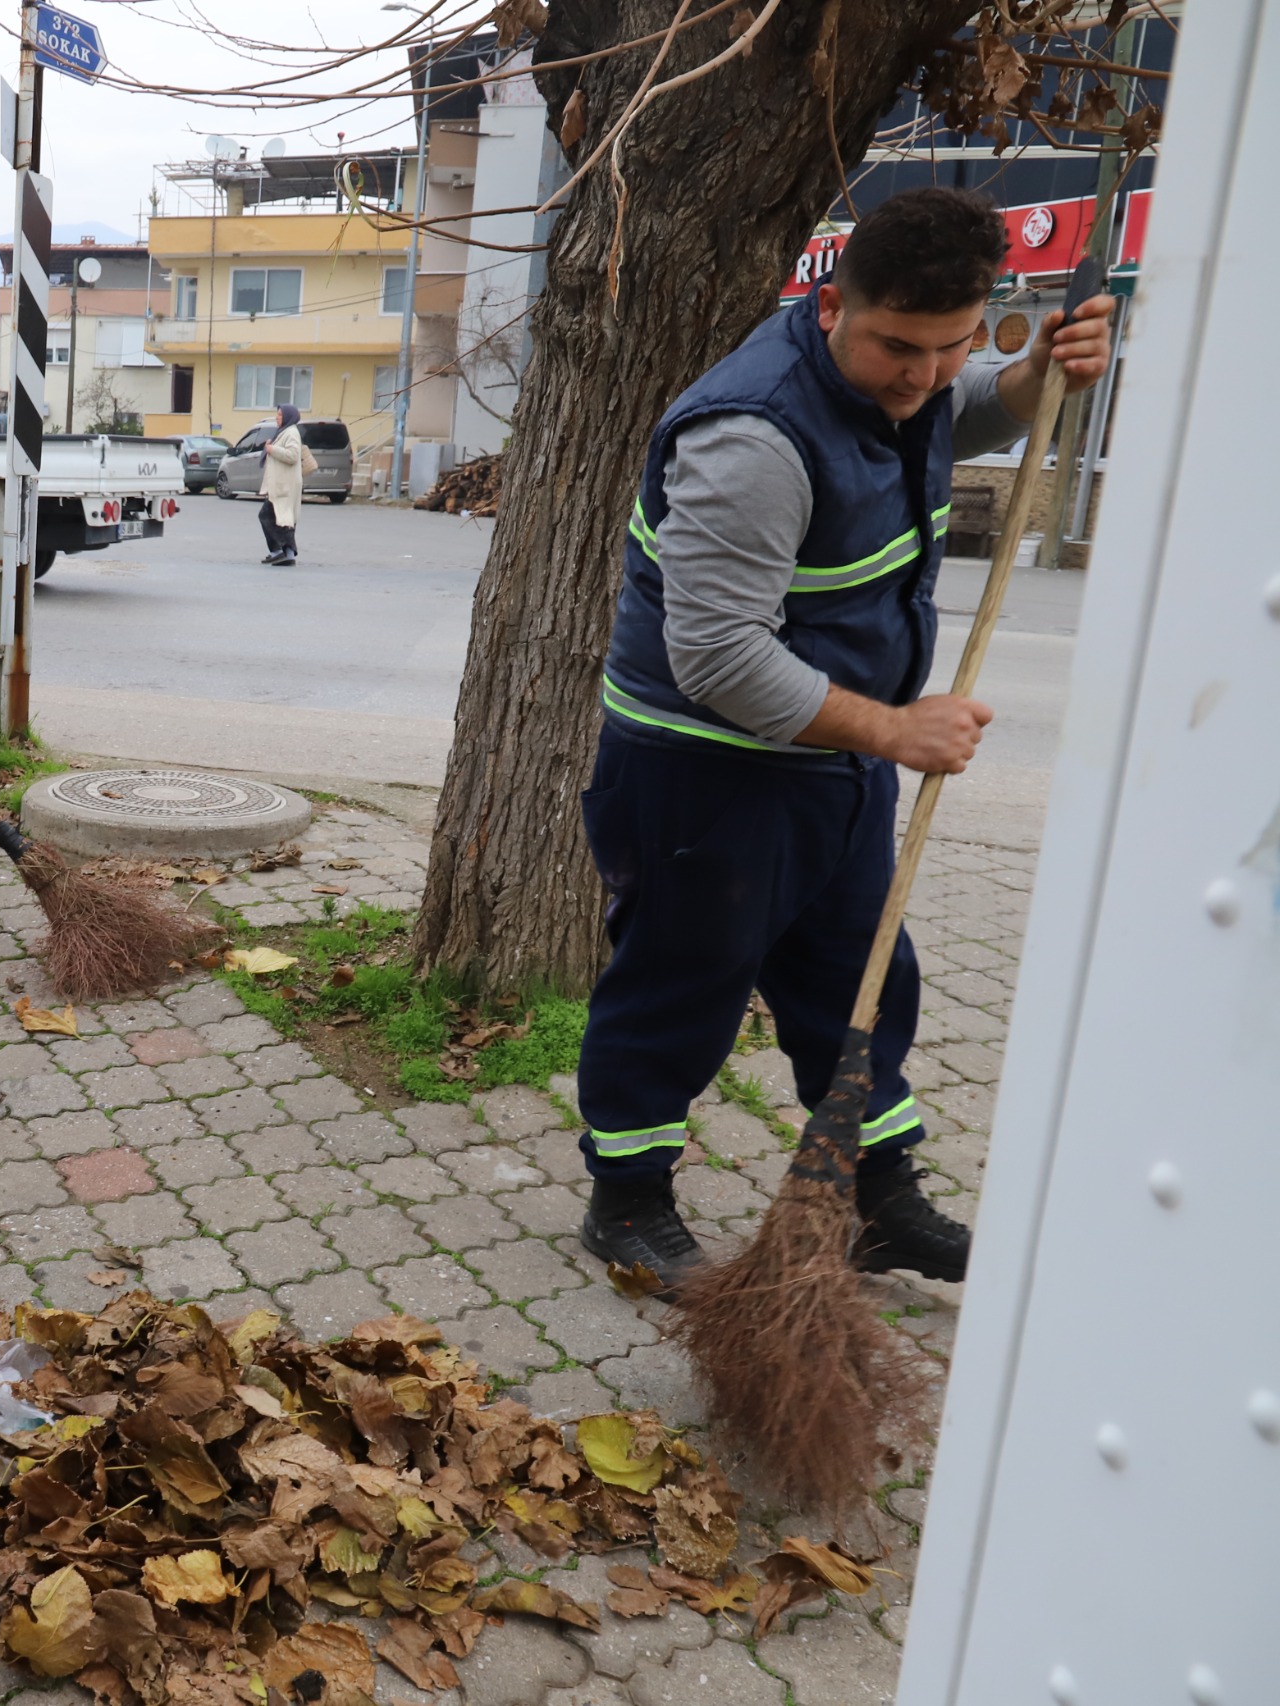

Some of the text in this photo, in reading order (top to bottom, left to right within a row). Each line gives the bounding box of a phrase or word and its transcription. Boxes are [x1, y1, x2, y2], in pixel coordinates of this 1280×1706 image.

[52, 15, 80, 39] 372
[38, 29, 90, 64] SOKAK
[795, 239, 844, 284] RÜ
